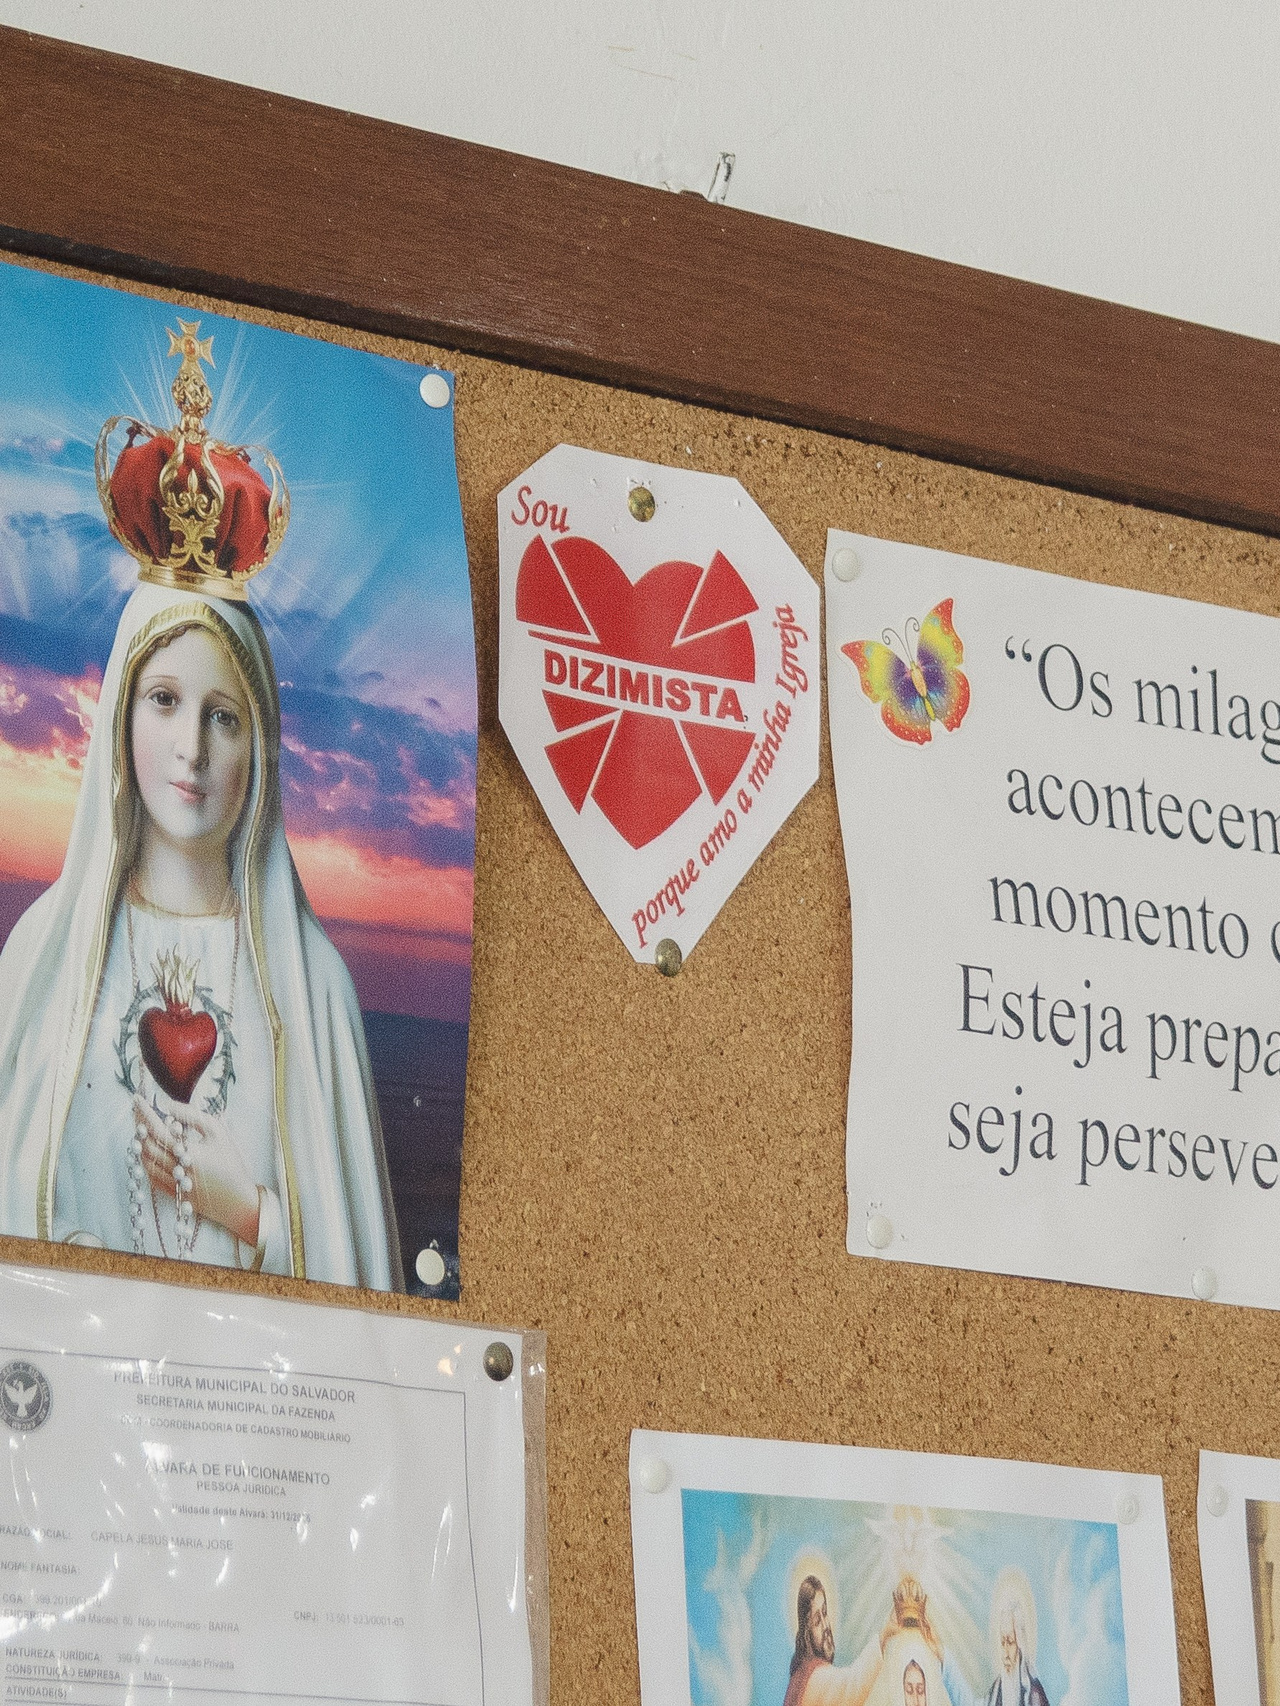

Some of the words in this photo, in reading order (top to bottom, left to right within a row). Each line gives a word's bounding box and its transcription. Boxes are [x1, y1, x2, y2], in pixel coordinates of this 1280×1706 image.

[511, 485, 570, 533] Sou
[543, 648, 746, 723] DIZIMISTA
[631, 863, 700, 949] porque
[699, 811, 739, 866] amo
[736, 794, 754, 815] a
[749, 704, 793, 795] minha
[774, 603, 810, 694] Igreja
[988, 875, 1250, 960] momento
[956, 962, 1128, 1069] Esteja
[947, 1085, 1058, 1177] seja
[195, 1378, 267, 1395] MUNICIPAL
[270, 1383, 289, 1396] DO
[292, 1385, 356, 1403] SALVADOR
[136, 1393, 204, 1411] SECRETARIA
[207, 1401, 269, 1415] MUNICIPAL
[271, 1405, 286, 1417] DA
[288, 1407, 335, 1421] FAZENDA
[150, 1417, 232, 1433] COORDENADORIA
[235, 1423, 248, 1433] DE
[250, 1424, 299, 1438] CADASTRO
[202, 1462, 220, 1476] DE
[224, 1464, 330, 1486] FUNCIONAMENTO
[196, 1481, 240, 1493] PESSOA
[34, 1529, 73, 1541] OCIAL:
[91, 1531, 134, 1544] CAPELA
[136, 1533, 169, 1546] JESUS
[170, 1535, 204, 1548] MARIA
[208, 1621, 240, 1633] BARRA
[5, 1648, 55, 1660] NATUREZA
